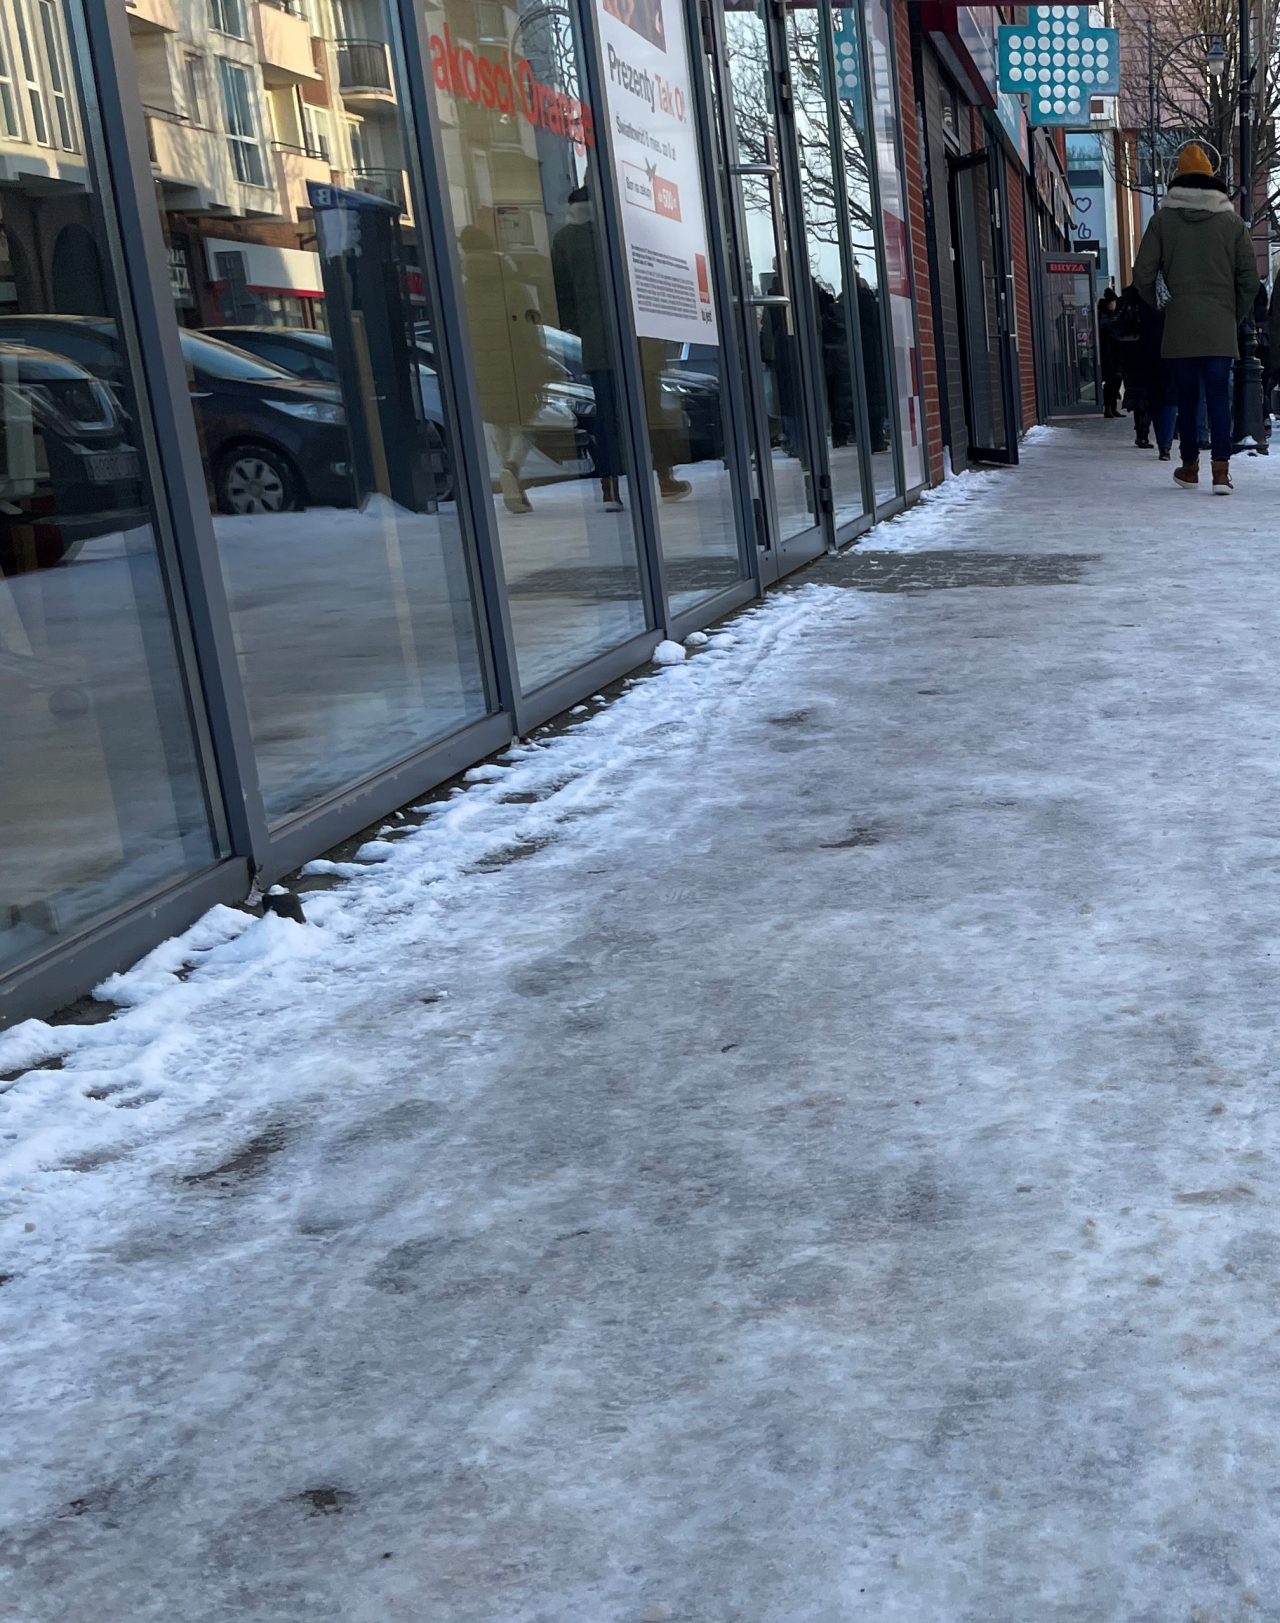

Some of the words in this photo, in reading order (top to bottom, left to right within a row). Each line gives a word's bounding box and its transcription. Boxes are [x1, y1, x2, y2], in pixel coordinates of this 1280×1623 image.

[517, 57, 595, 157] Orange
[607, 42, 655, 113] Prezenty
[655, 74, 675, 119] Tak
[1050, 263, 1085, 272] BRYZA
